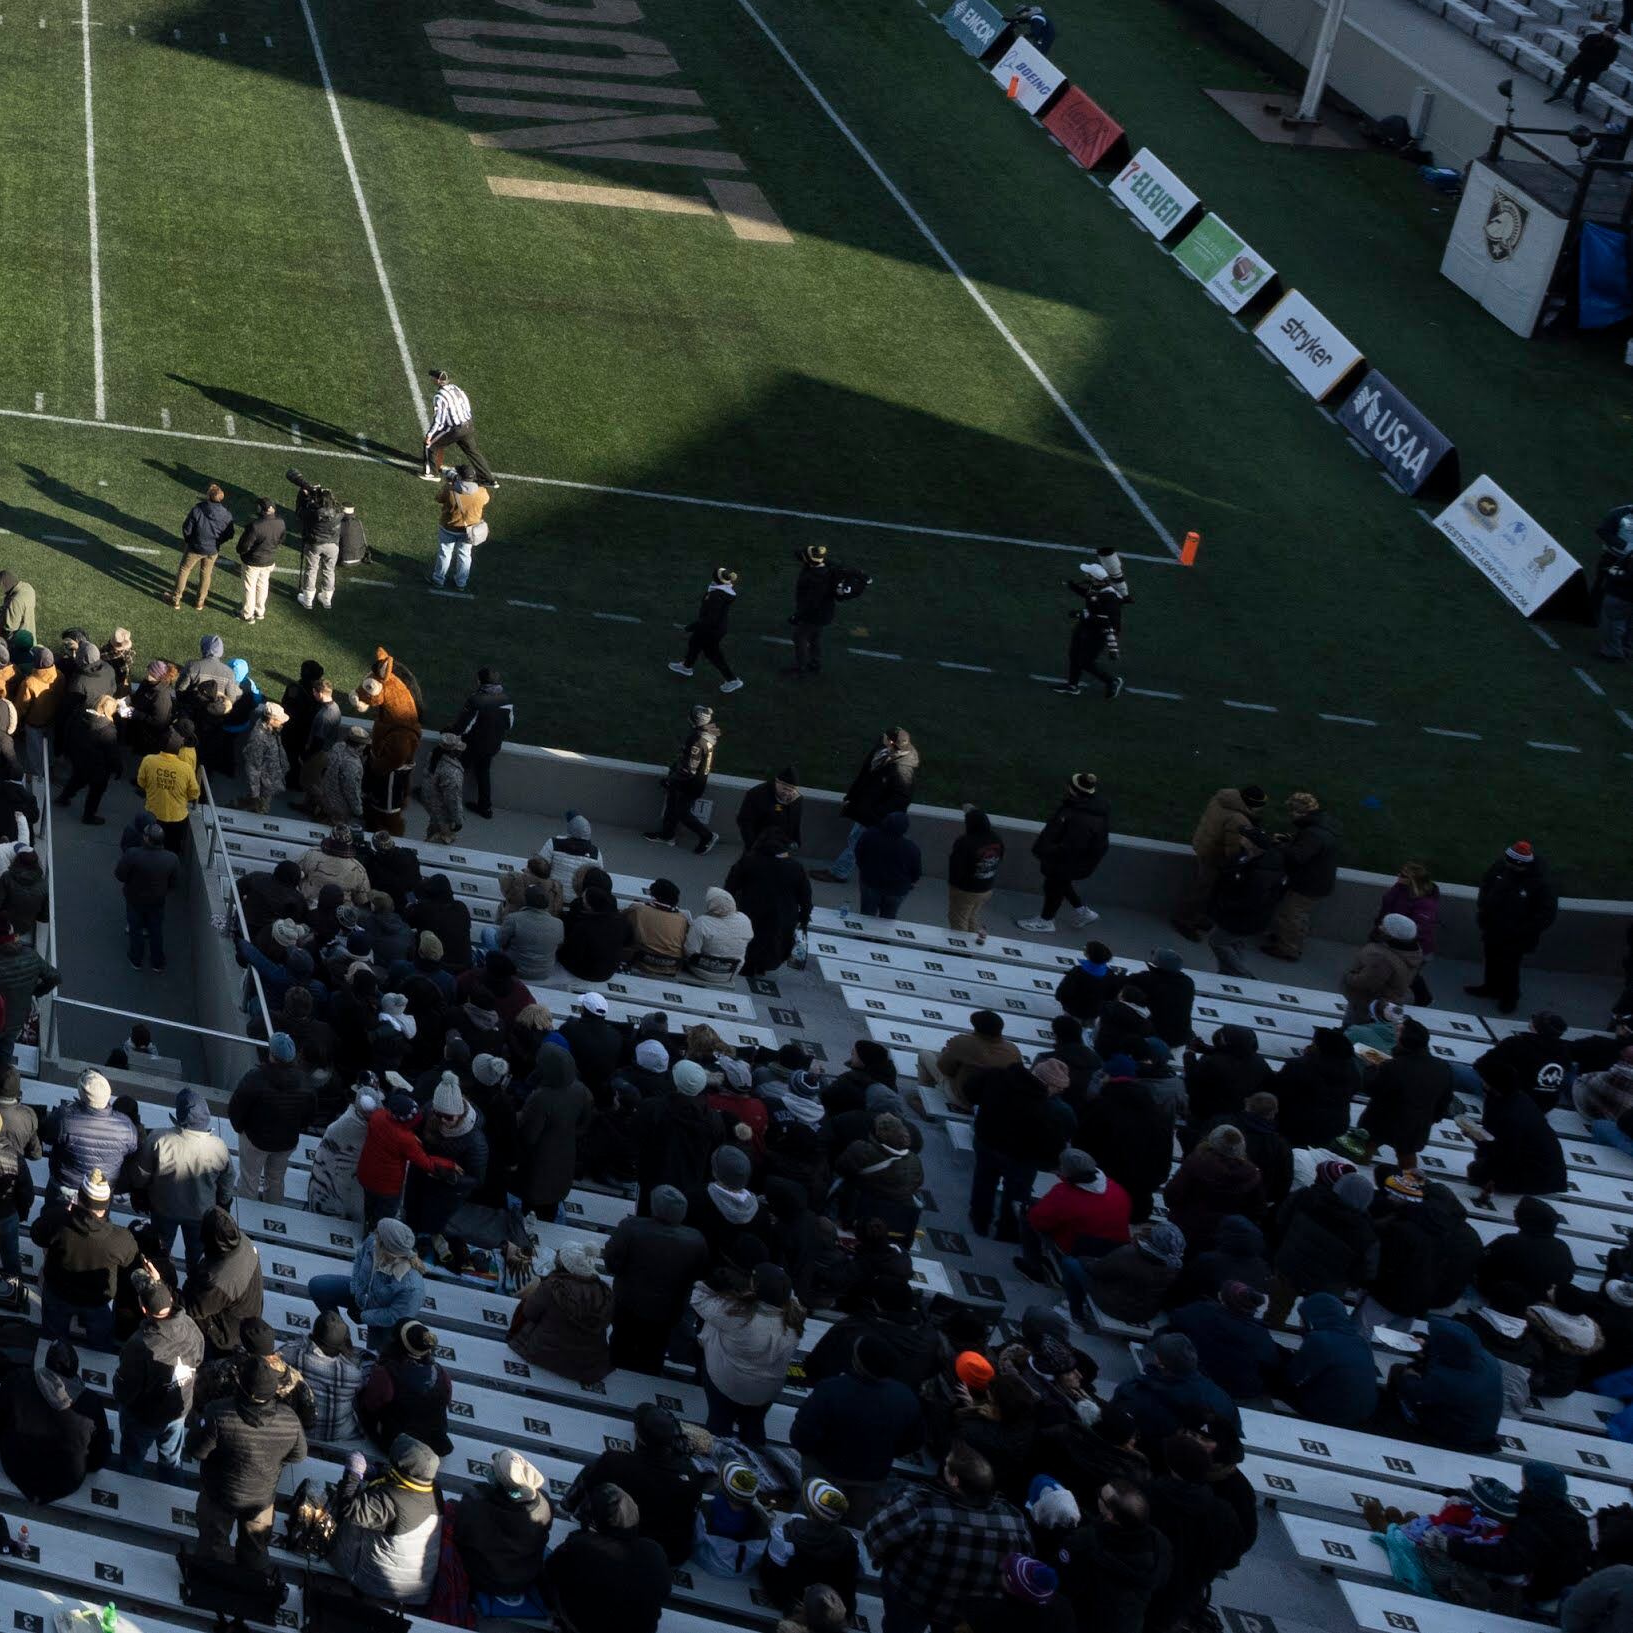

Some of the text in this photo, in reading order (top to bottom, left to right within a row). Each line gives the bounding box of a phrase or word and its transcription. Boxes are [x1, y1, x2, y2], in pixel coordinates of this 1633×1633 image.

[960, 7, 995, 45] EMCOR
[1015, 62, 1051, 96] BOEING
[1281, 317, 1333, 367] stryker
[1374, 410, 1429, 479] USAA
[1441, 520, 1529, 608] WESTPOINT.ARMYMWR.COM
[156, 768, 177, 779] CSC
[156, 777, 176, 787] EVENT
